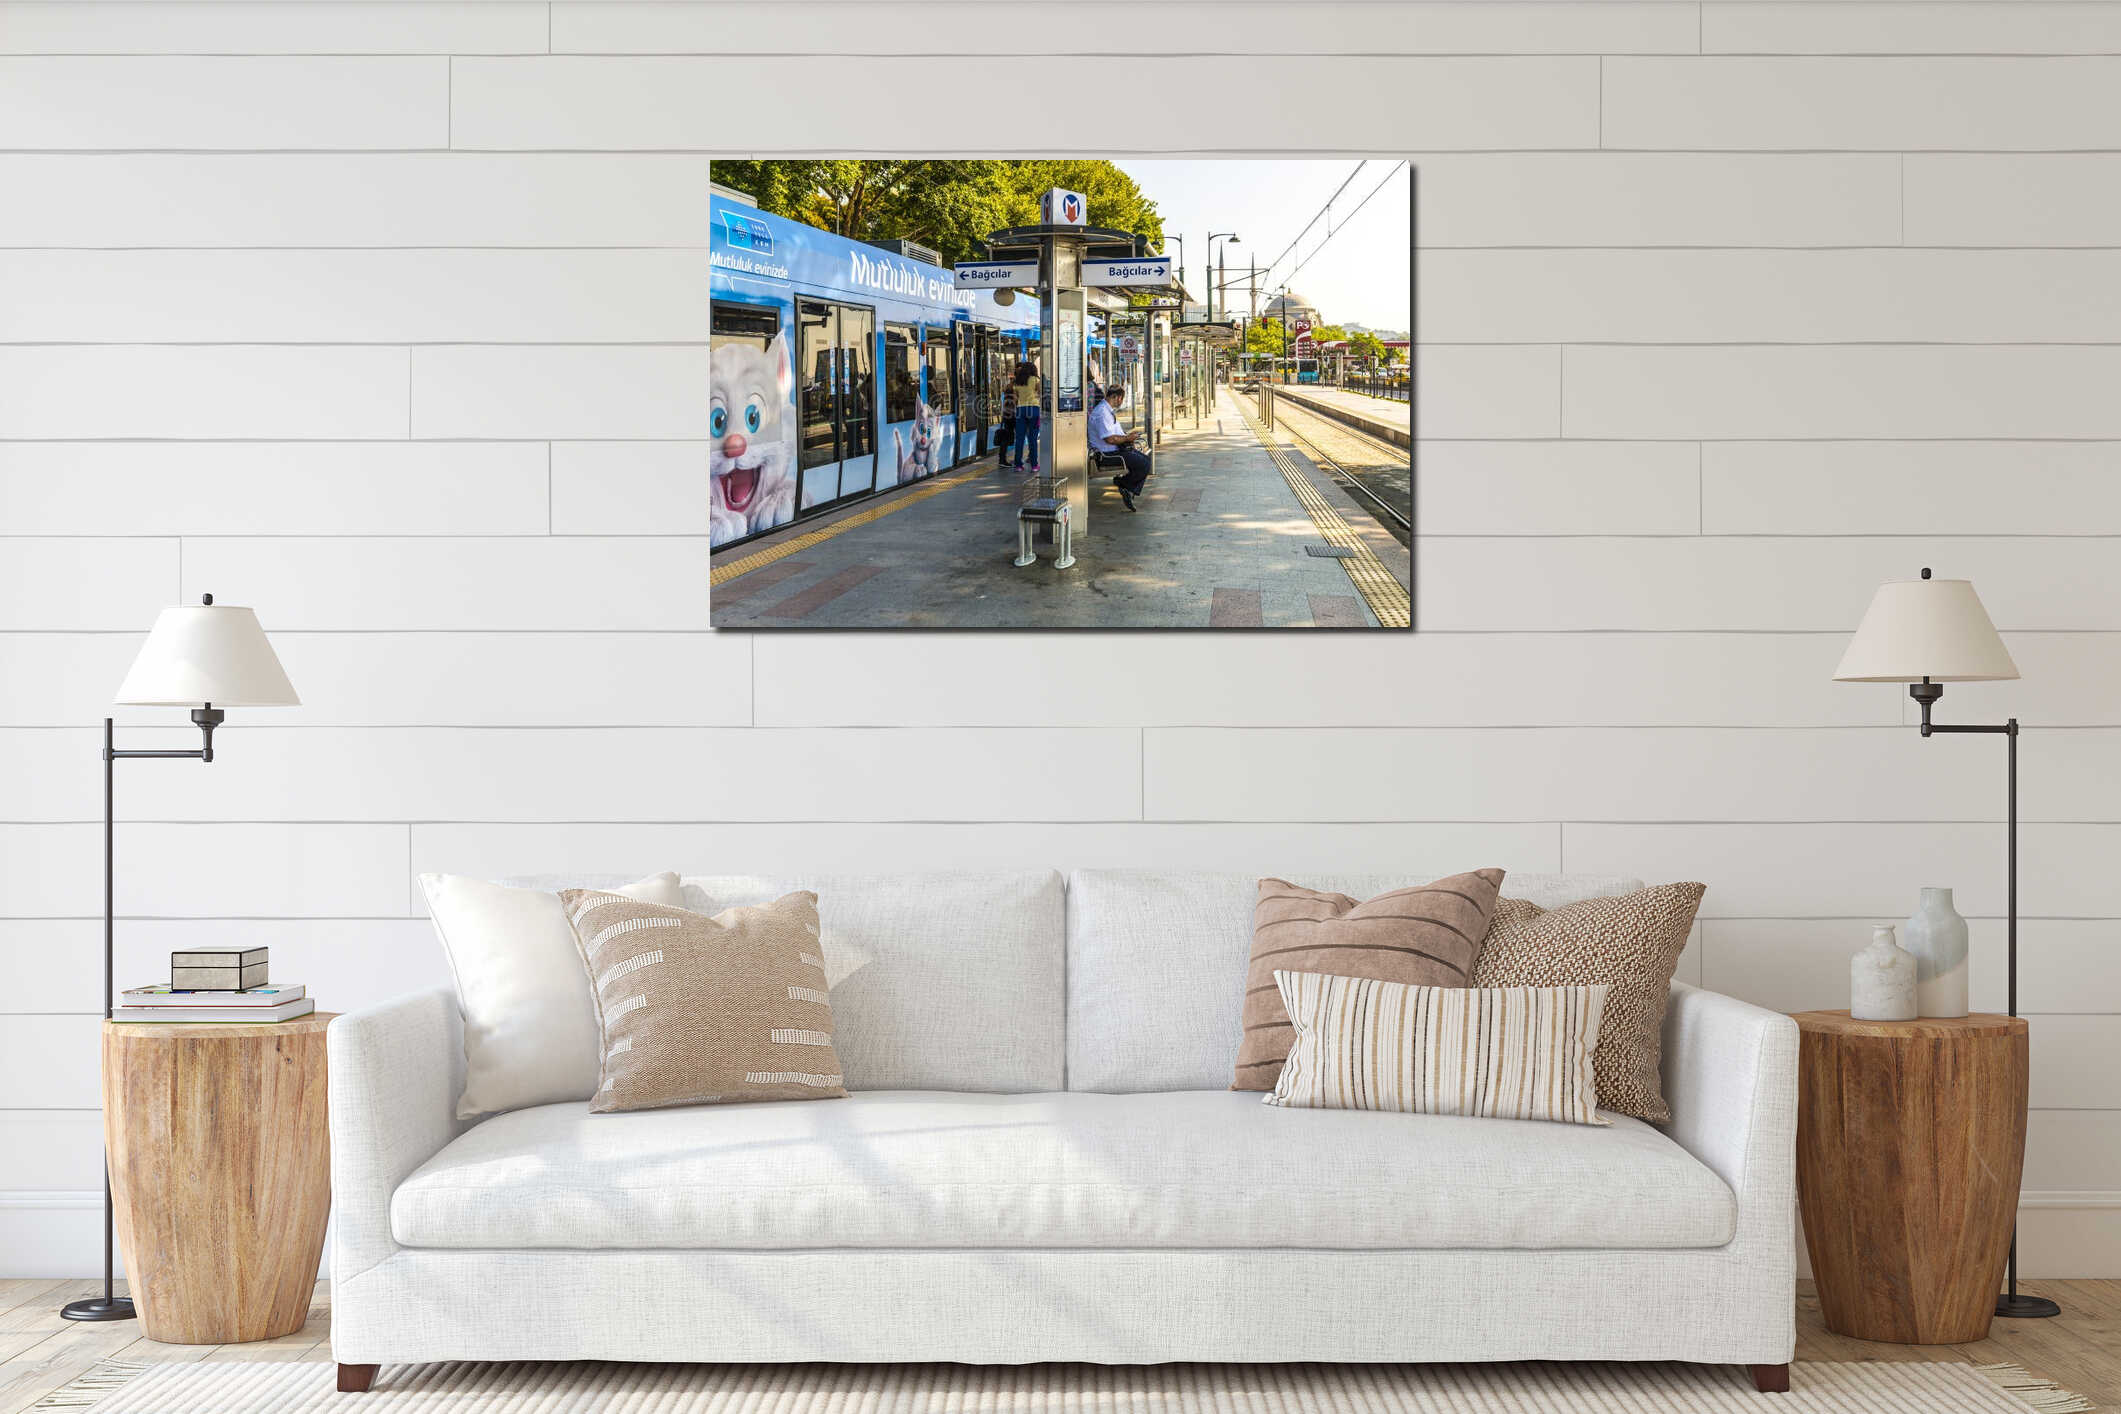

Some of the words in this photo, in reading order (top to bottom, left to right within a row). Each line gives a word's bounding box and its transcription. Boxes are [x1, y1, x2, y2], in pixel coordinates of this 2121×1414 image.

[710, 251, 753, 273] Mutluluk
[754, 262, 789, 280] evinizde
[850, 250, 926, 298] Mutluluk
[971, 268, 1012, 281] Bağcılar
[1108, 266, 1153, 280] Bağcılar
